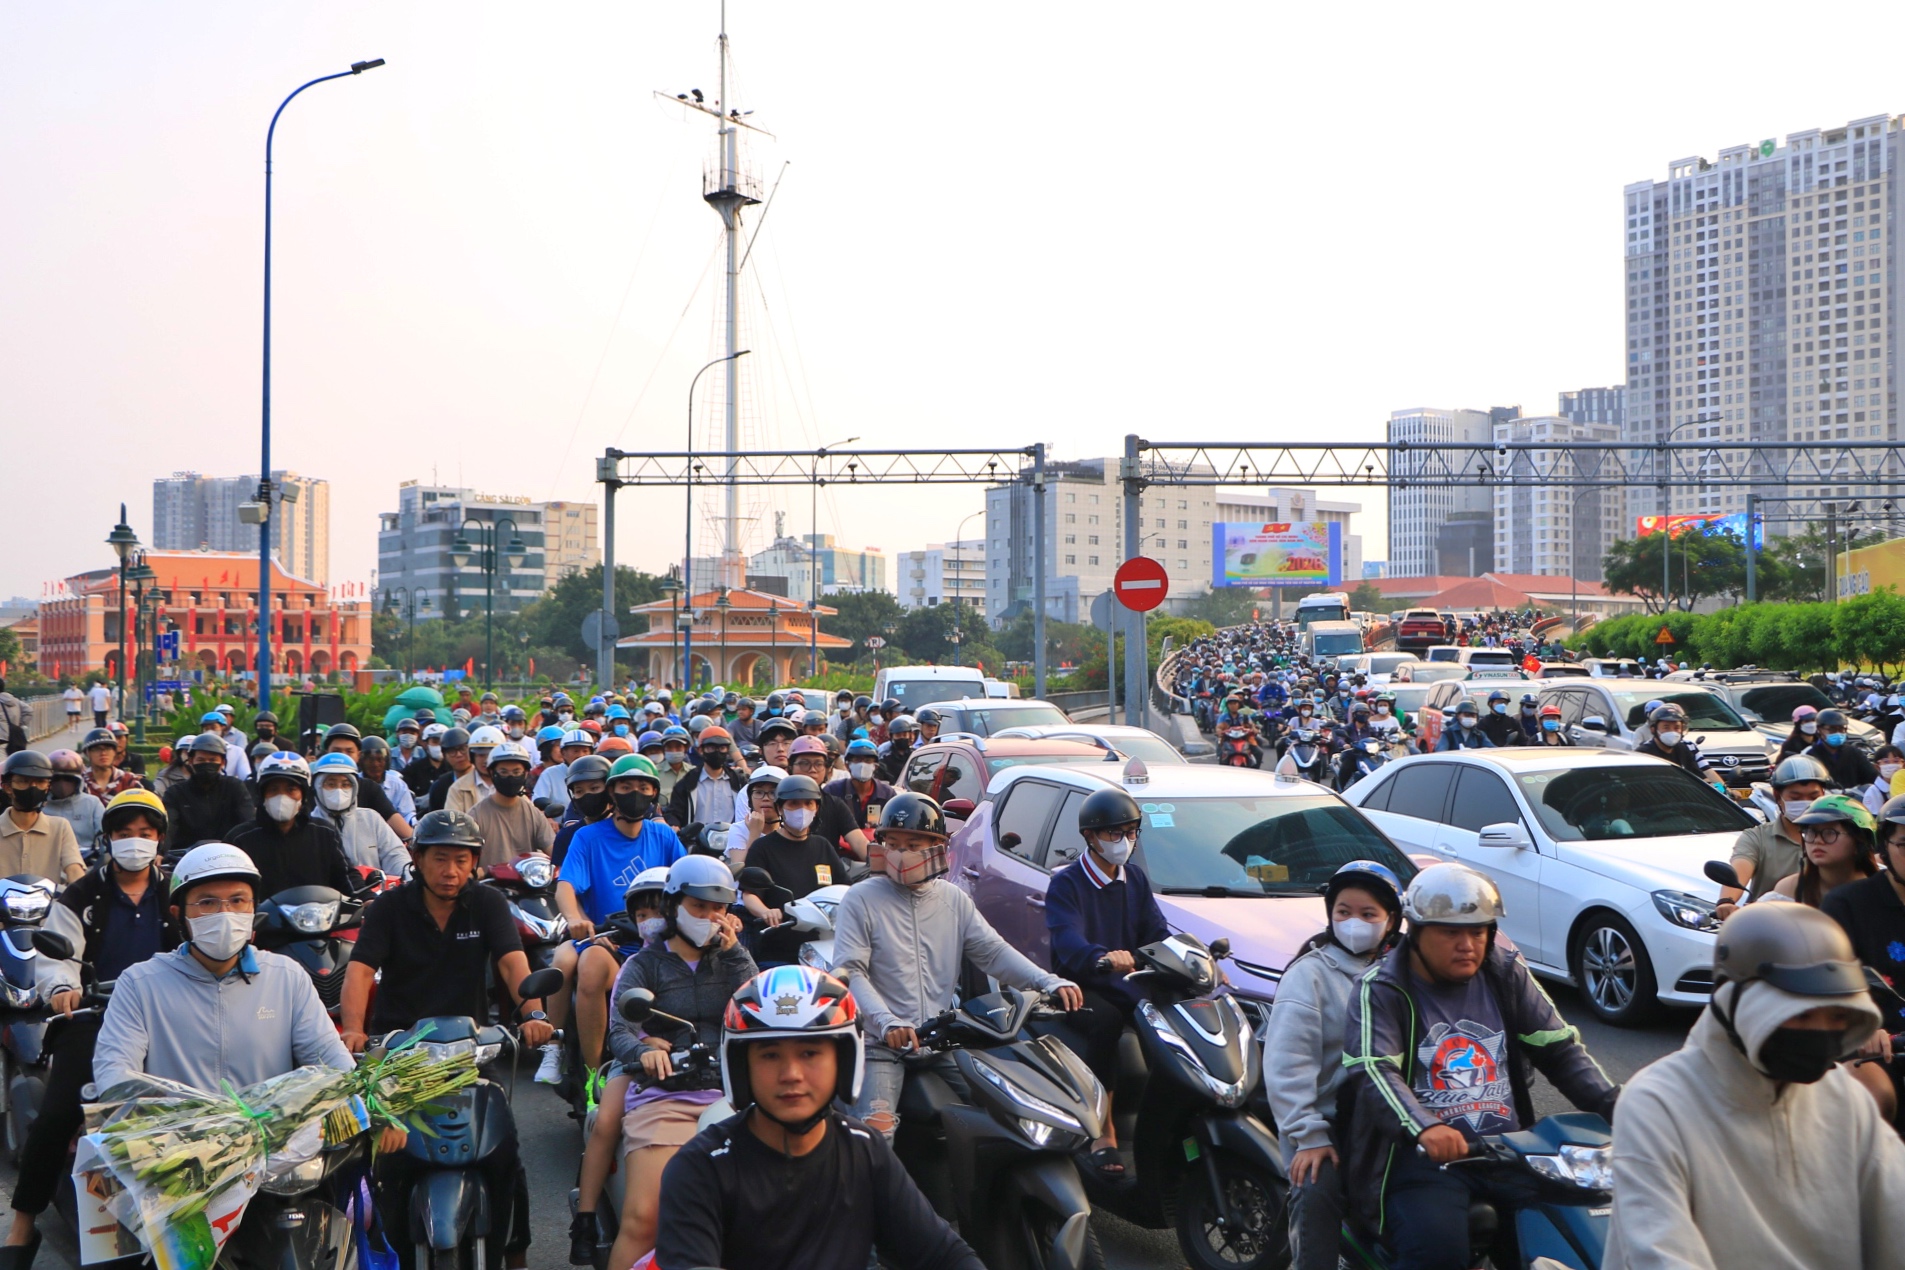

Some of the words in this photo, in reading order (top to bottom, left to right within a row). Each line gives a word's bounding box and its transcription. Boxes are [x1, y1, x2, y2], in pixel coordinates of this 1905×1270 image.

[1286, 557, 1324, 571] 2026
[1416, 1089, 1468, 1104] Blue
[1440, 1103, 1475, 1118] AMERICAN
[1478, 1102, 1501, 1110] LEAGUE
